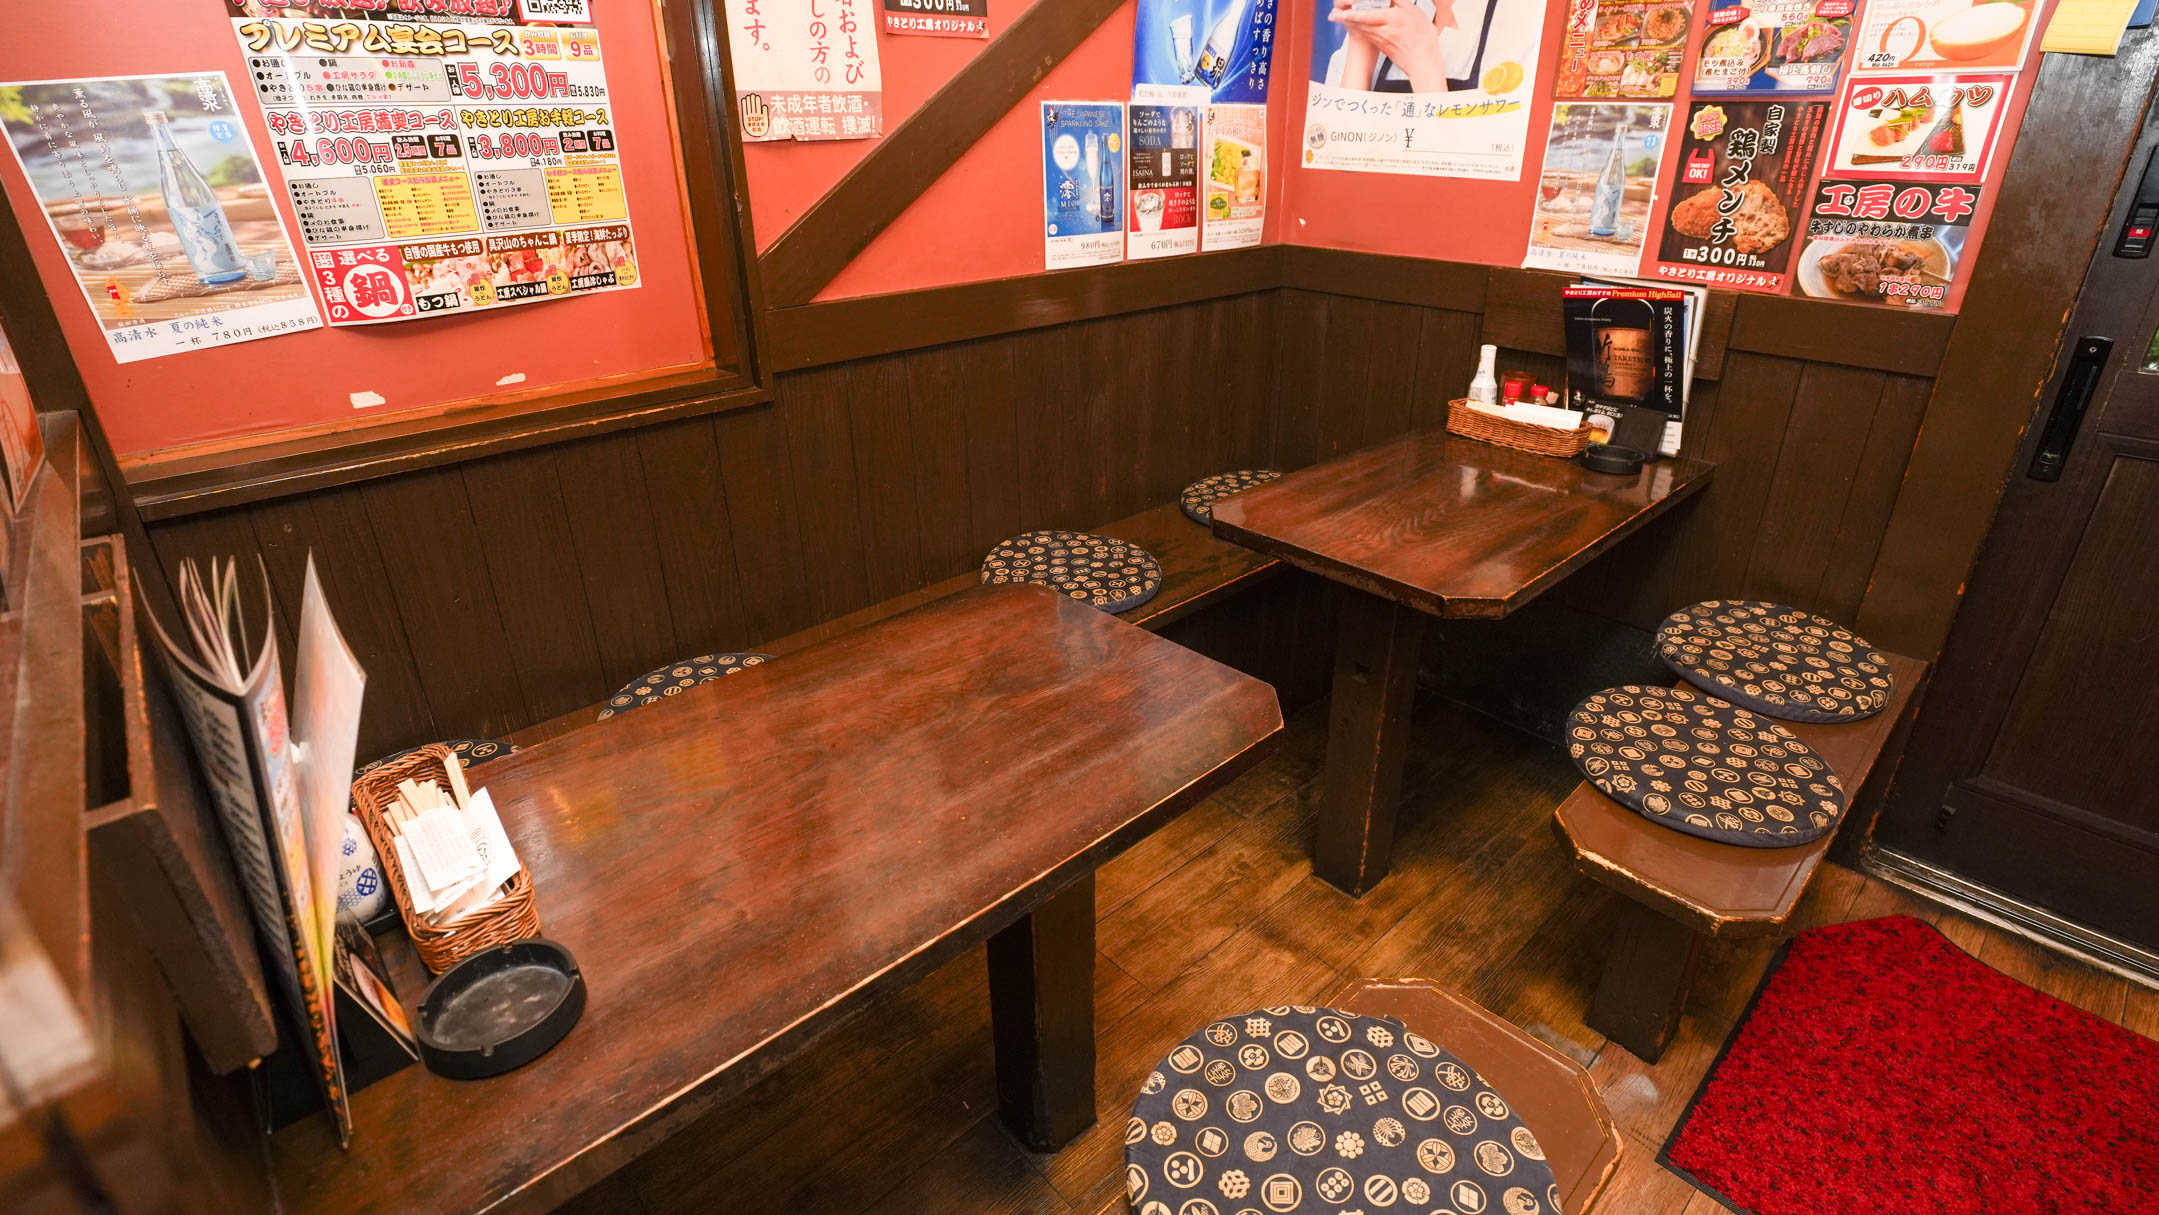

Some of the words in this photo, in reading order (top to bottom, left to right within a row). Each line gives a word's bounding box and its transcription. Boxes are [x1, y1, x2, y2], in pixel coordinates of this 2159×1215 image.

[887, 15, 974, 32] やきとり工房オリジナル
[240, 19, 519, 56] プレミアム宴会コース
[522, 39, 558, 56] 3時間
[570, 41, 594, 57] 9品
[457, 62, 569, 100] 5,300円
[1311, 93, 1521, 119] ジンでつくった「通」なレモンサワー
[267, 109, 457, 135] やきとり工房満喫コース
[460, 107, 609, 129] やきとり工房お手軽コース
[772, 116, 836, 135] 飲酒運転
[1759, 104, 1786, 154] 自家製
[477, 132, 560, 160] 3,800円
[1138, 136, 1161, 146] SODA
[1404, 128, 1415, 148] ¥
[290, 137, 393, 167] 4,600円
[1900, 155, 1949, 171] 290円
[1689, 168, 1708, 179] OK!
[1711, 128, 1759, 245] 鶏メンチ
[1816, 183, 1976, 222] 工房の牛
[1809, 219, 1935, 241] 牛すじのやわらか煮串
[404, 239, 480, 261] 自慢の国産牛もつ使用
[488, 233, 558, 252] 具沢山のちゃんこ鍋
[338, 248, 390, 266] 選べる
[1697, 246, 1747, 266] 300円
[1658, 265, 1766, 287] やきとり工房オリジナル
[322, 270, 349, 319] 3種の
[350, 270, 399, 308] 鍋
[1612, 289, 1647, 298] Premium
[1648, 291, 1682, 300] HighBall
[418, 294, 459, 311] もつ鍋
[112, 327, 158, 344] 高清水
[168, 315, 224, 335] 夏の純米
[175, 336, 203, 346] 一杯
[212, 327, 252, 342] 780円
[257, 315, 319, 335] (税込858円)
[1663, 306, 1674, 404] 炭火の香りに、極上の一杯を。
